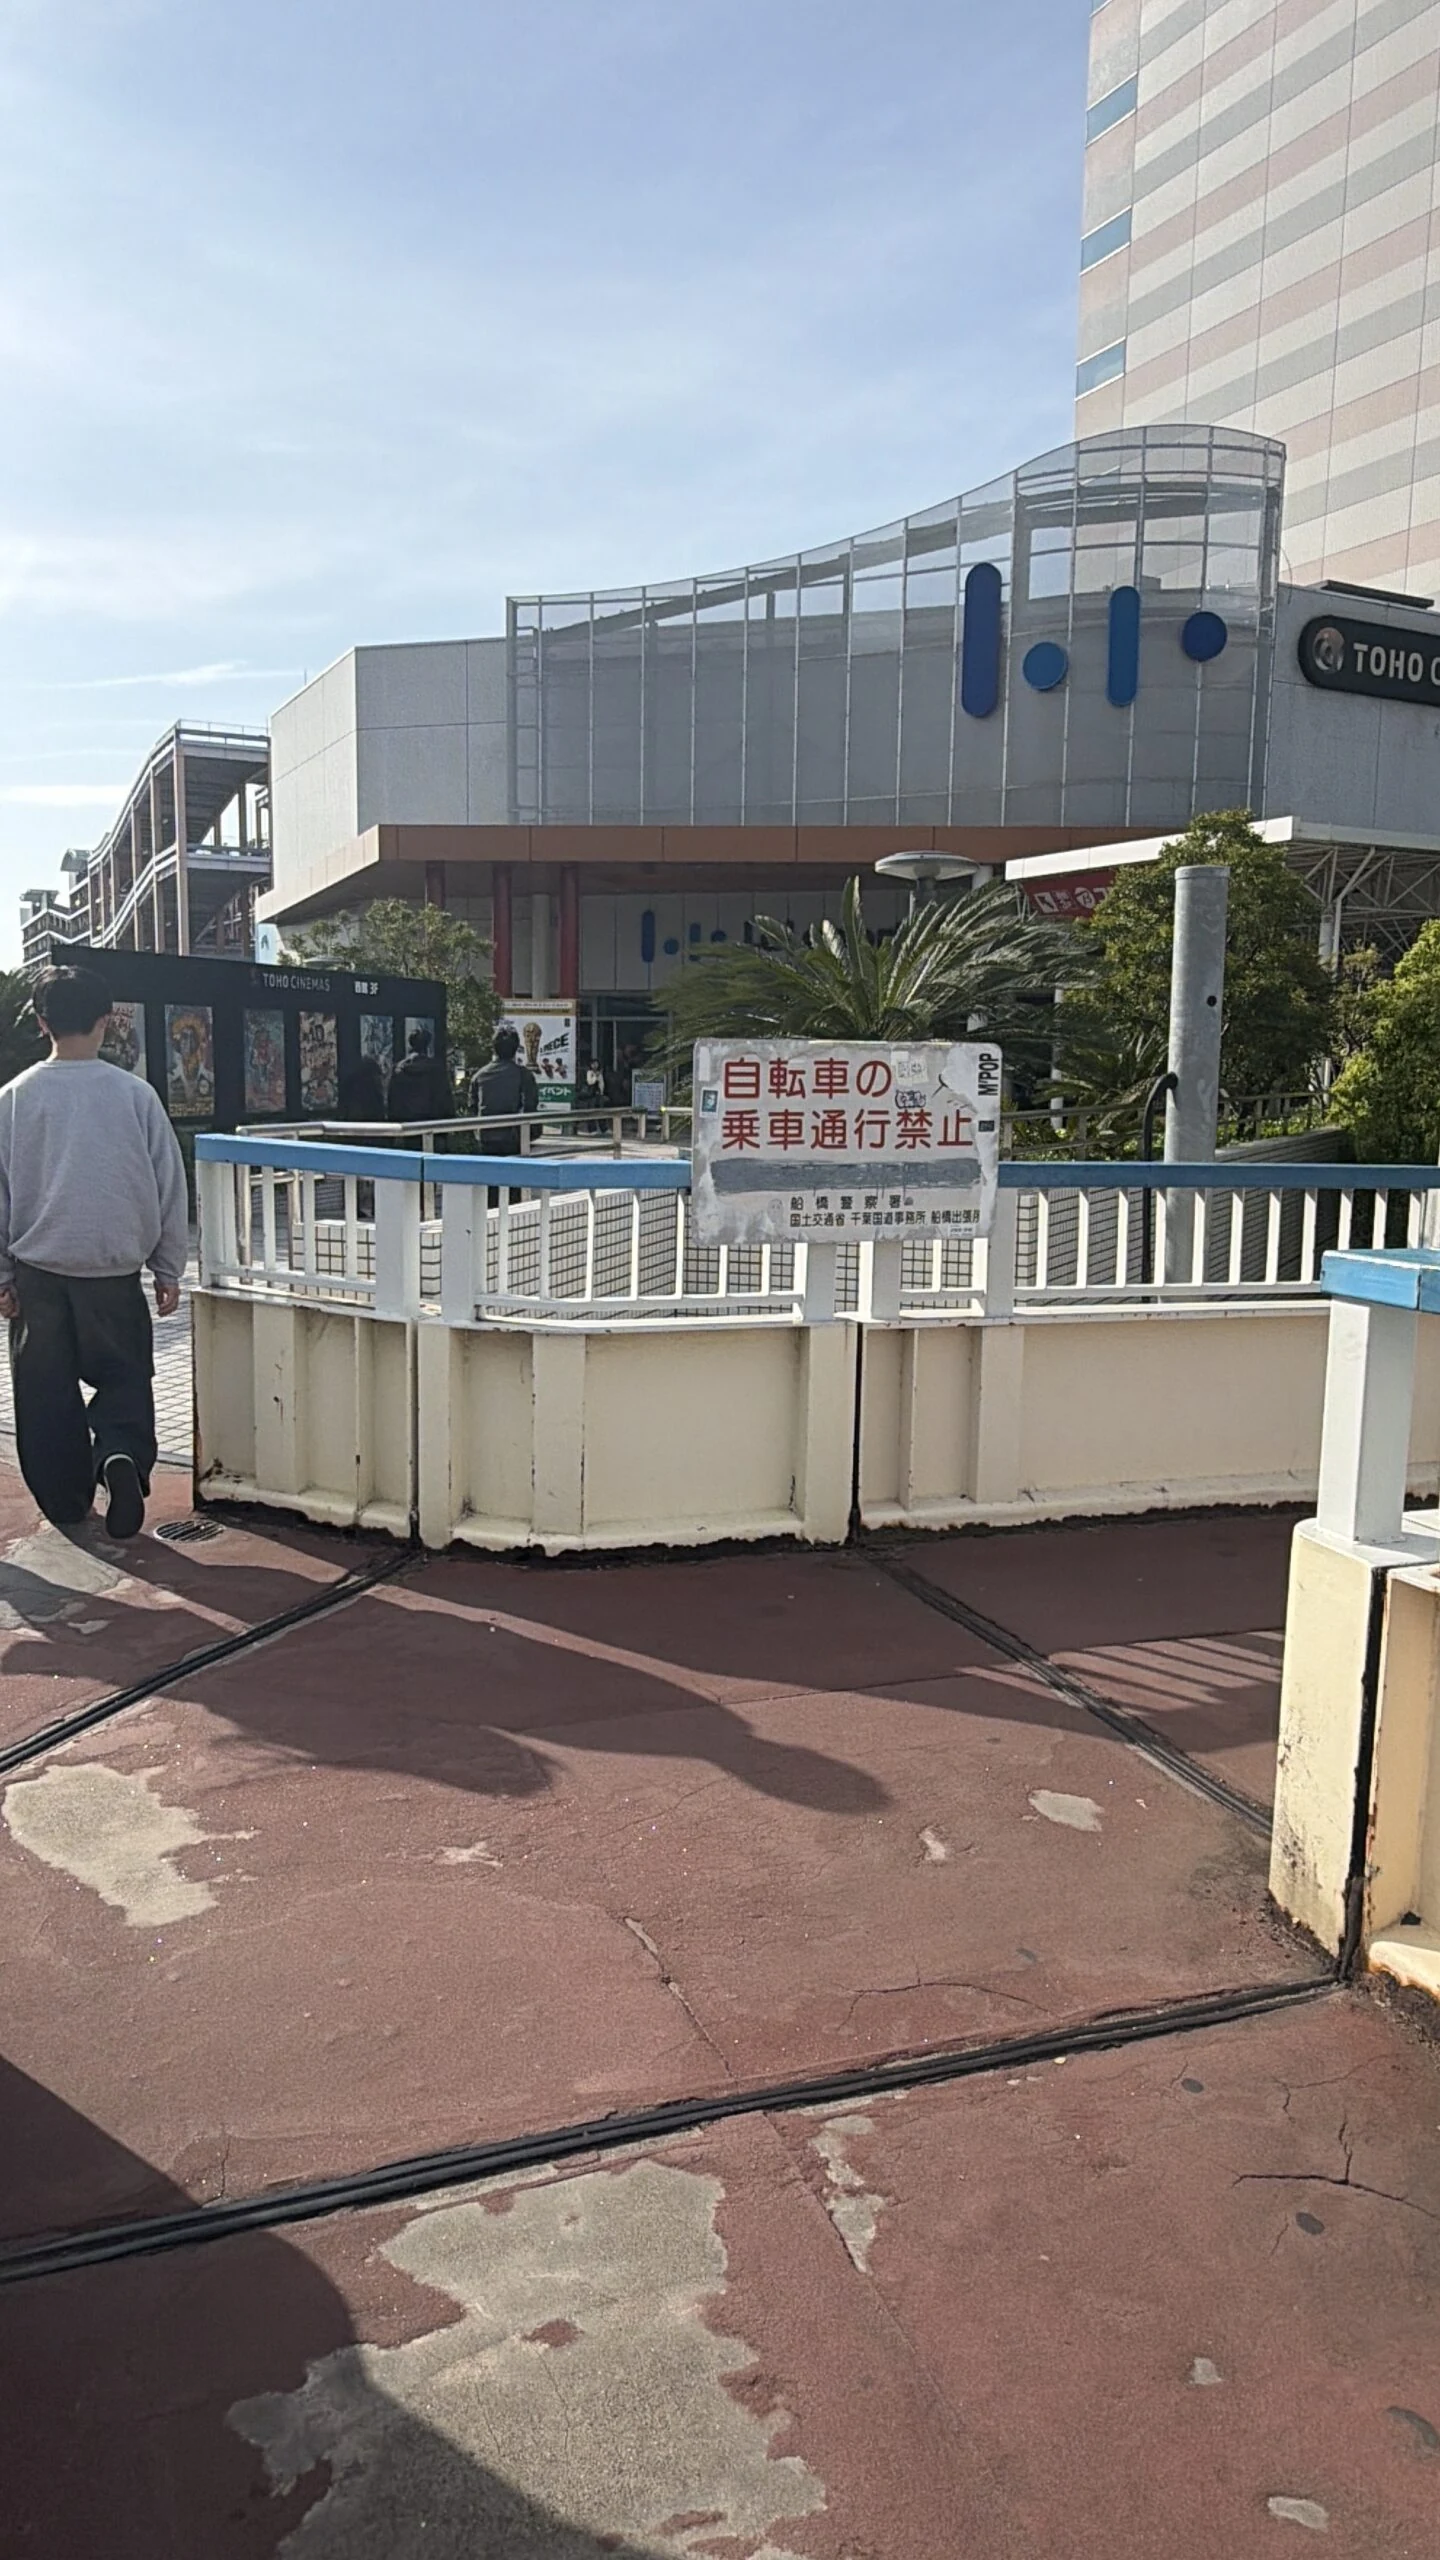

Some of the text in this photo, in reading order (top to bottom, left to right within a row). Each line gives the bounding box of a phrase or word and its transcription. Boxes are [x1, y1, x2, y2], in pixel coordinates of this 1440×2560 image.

[1353, 642, 1424, 682] TOHO
[263, 972, 331, 992] TOHO CINEMAS
[723, 1057, 892, 1099] 自転車の
[722, 1109, 973, 1150] 乗車通行禁止
[790, 1213, 845, 1228] 国土交通省
[851, 1211, 926, 1226] 千葉国道事務所
